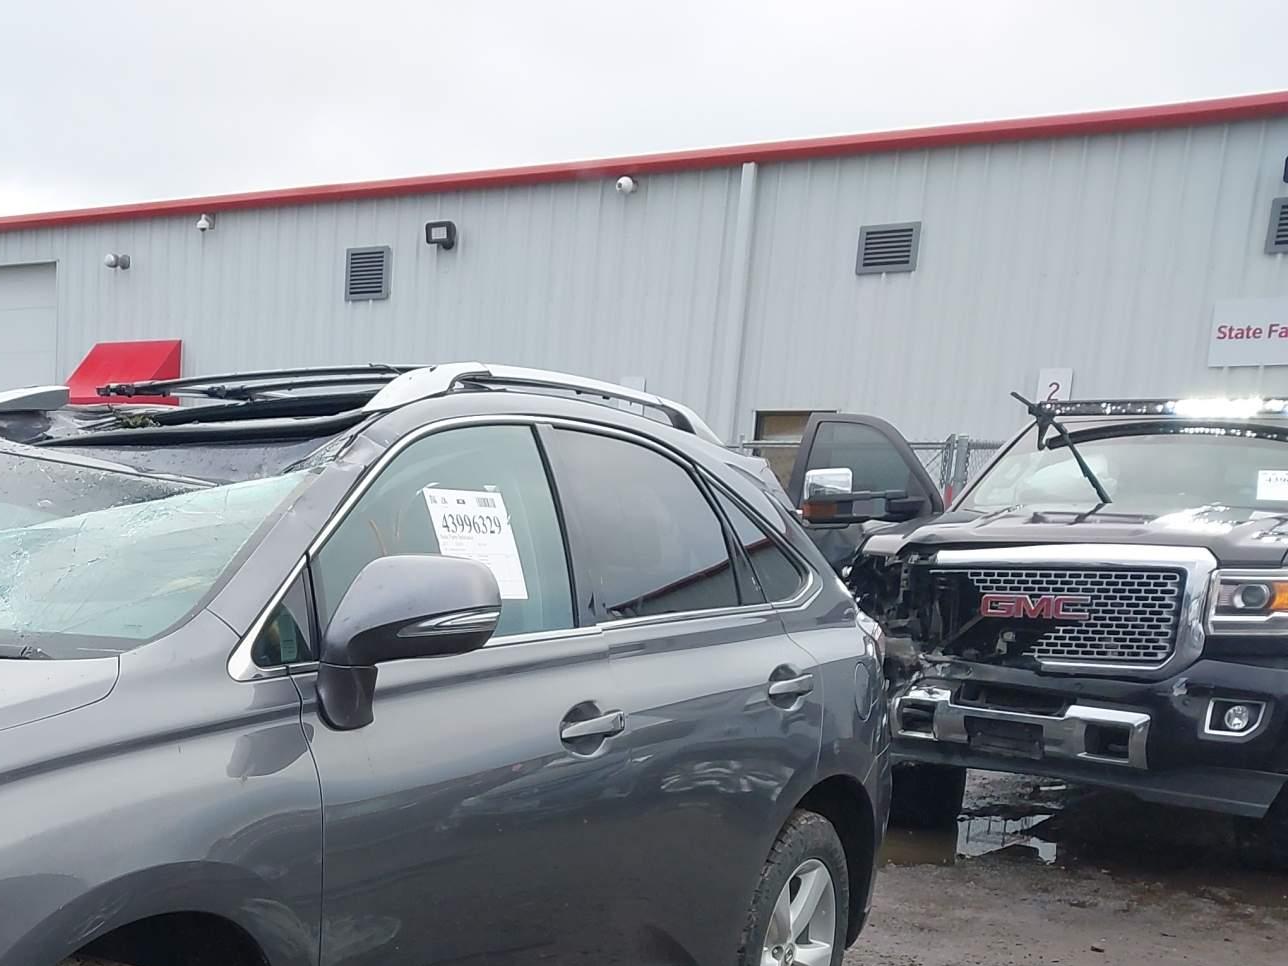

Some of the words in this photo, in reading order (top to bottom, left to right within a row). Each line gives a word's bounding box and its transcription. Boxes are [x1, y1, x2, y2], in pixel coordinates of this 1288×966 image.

[1216, 324, 1263, 340] State
[1046, 382, 1060, 403] 2
[442, 513, 502, 534] 43996329
[981, 593, 1091, 621] GMC
